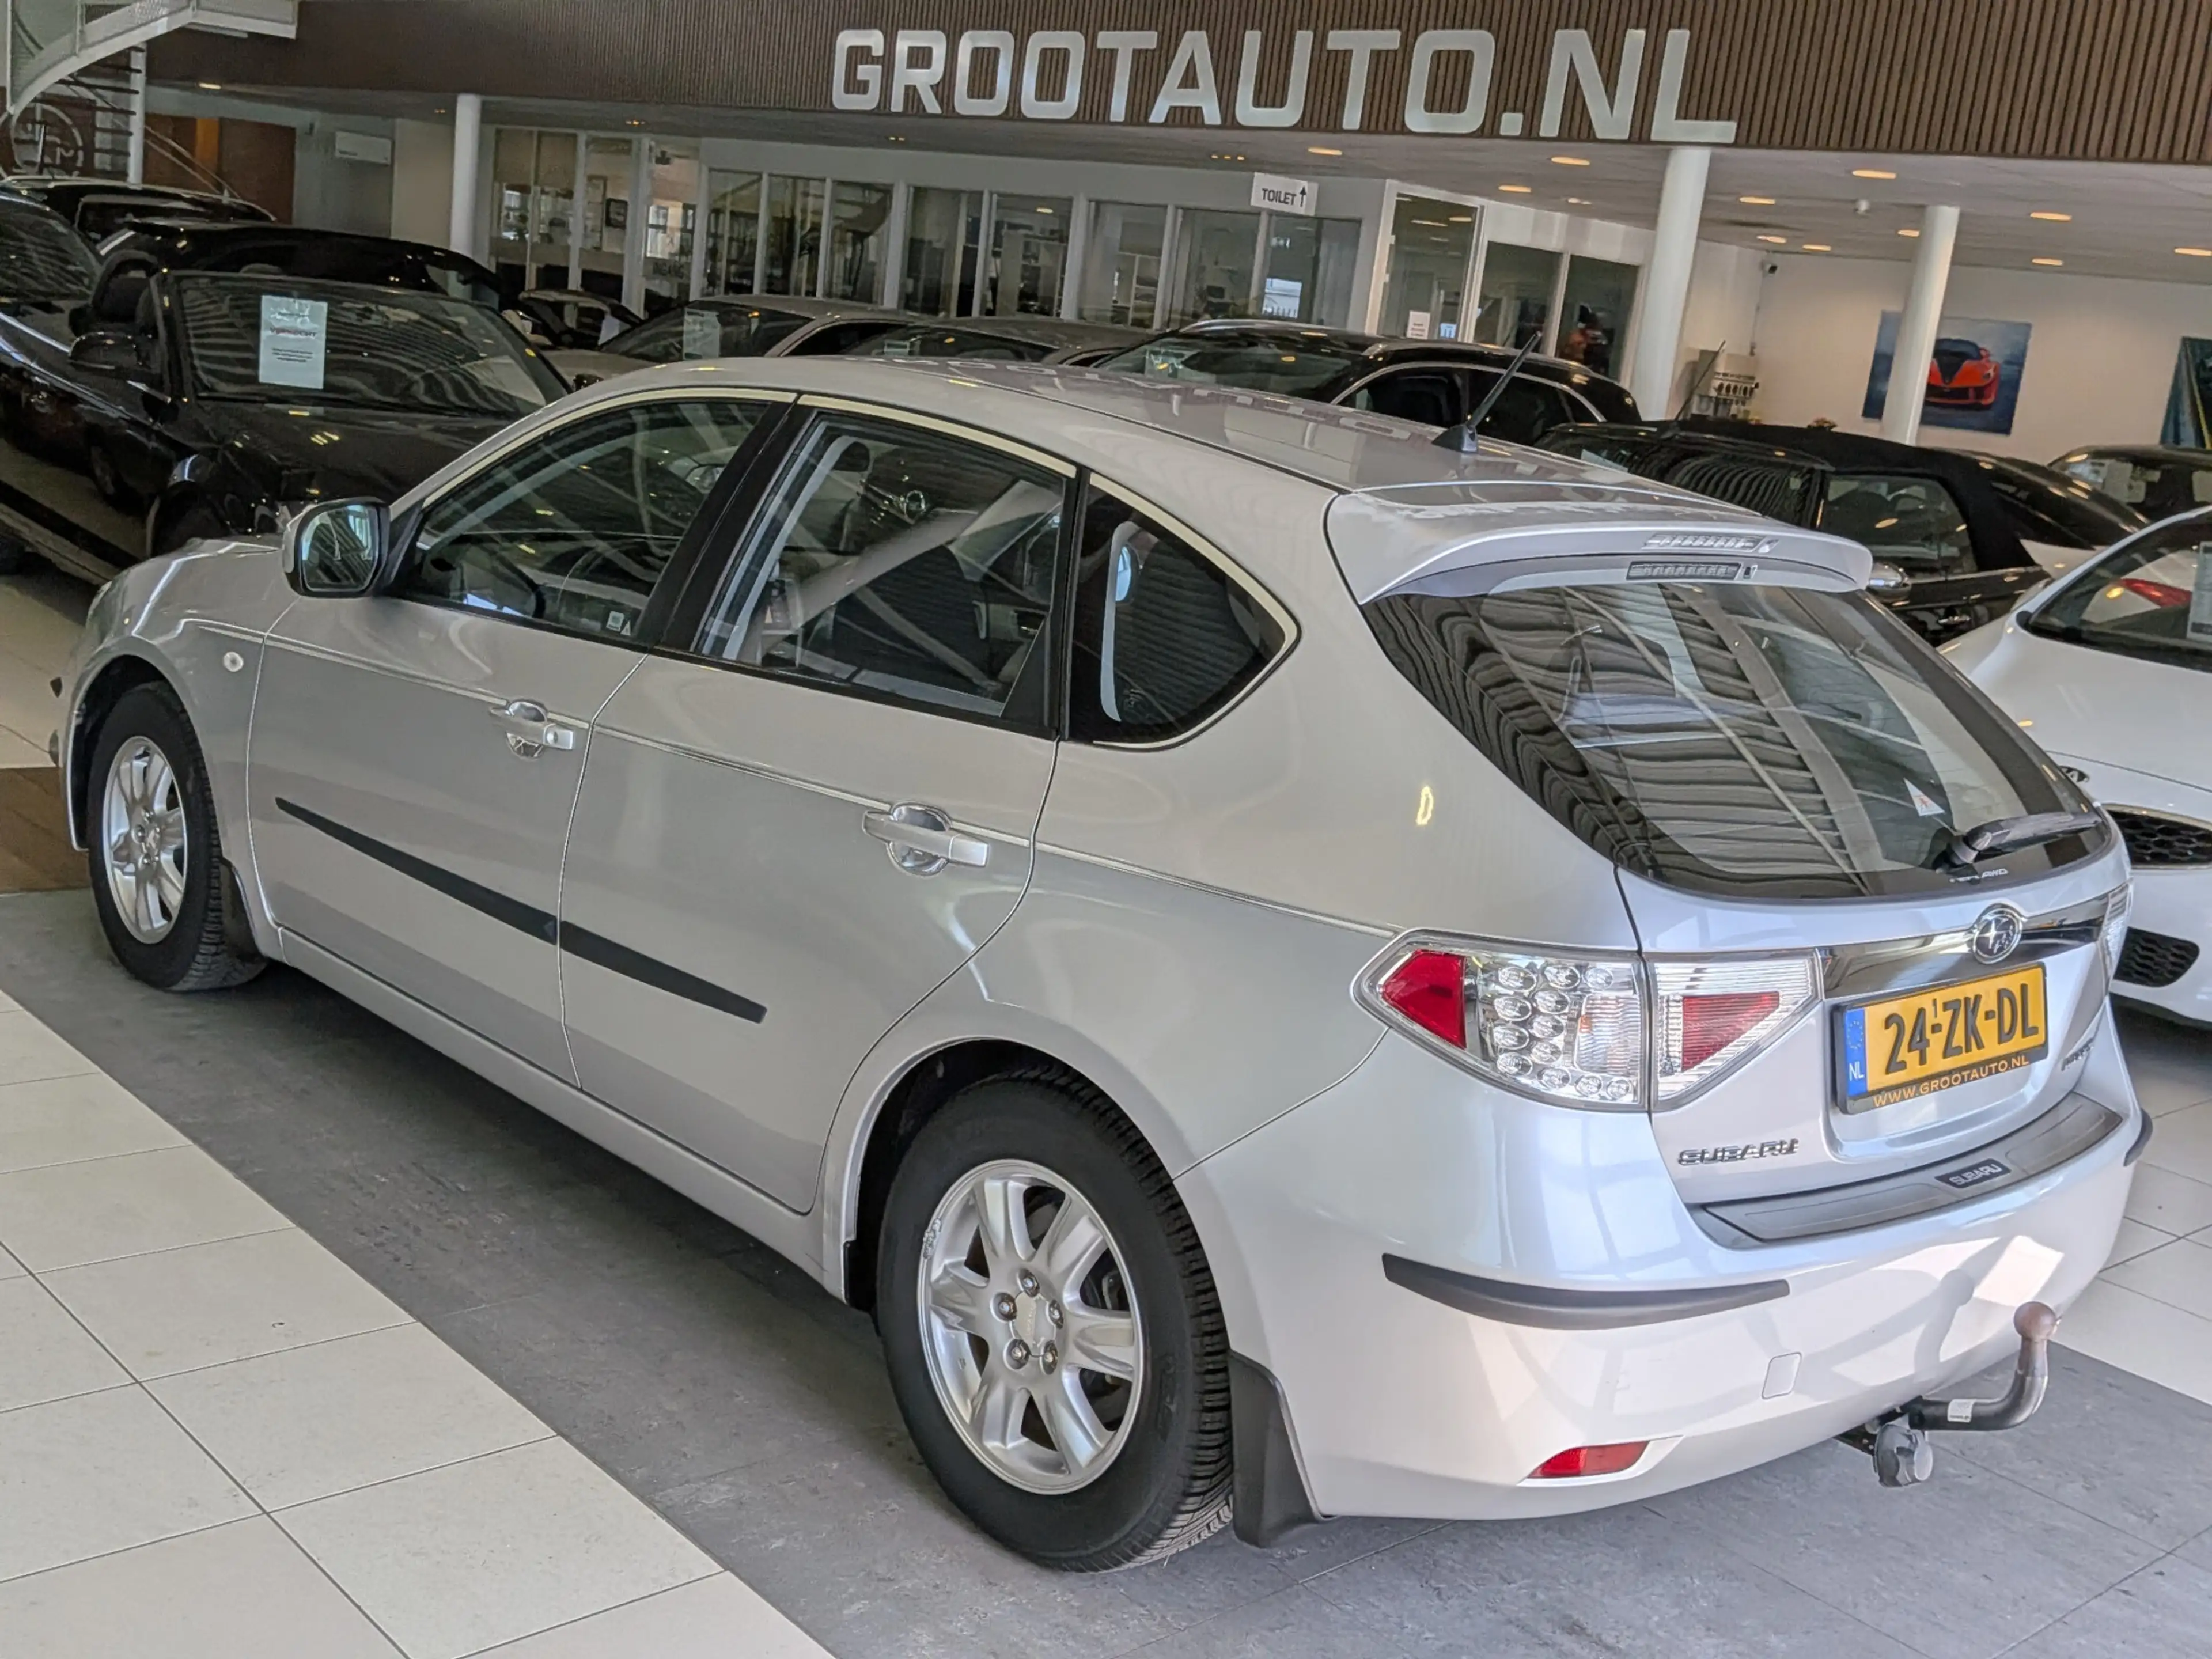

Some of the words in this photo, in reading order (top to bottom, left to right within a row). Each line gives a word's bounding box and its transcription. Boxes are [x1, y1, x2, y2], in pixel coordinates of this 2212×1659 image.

[832, 28, 1737, 143] GROOTAUTO.NL
[1262, 188, 1297, 206] TOILET
[1884, 983, 2039, 1075] 24-ZK-DL
[1849, 1061, 1865, 1081] NL
[1873, 1055, 2030, 1107] WWW.GROOTAUTO.NL
[1677, 1138, 1799, 1166] SUBARU
[1949, 1164, 2002, 1185] SUBARU
